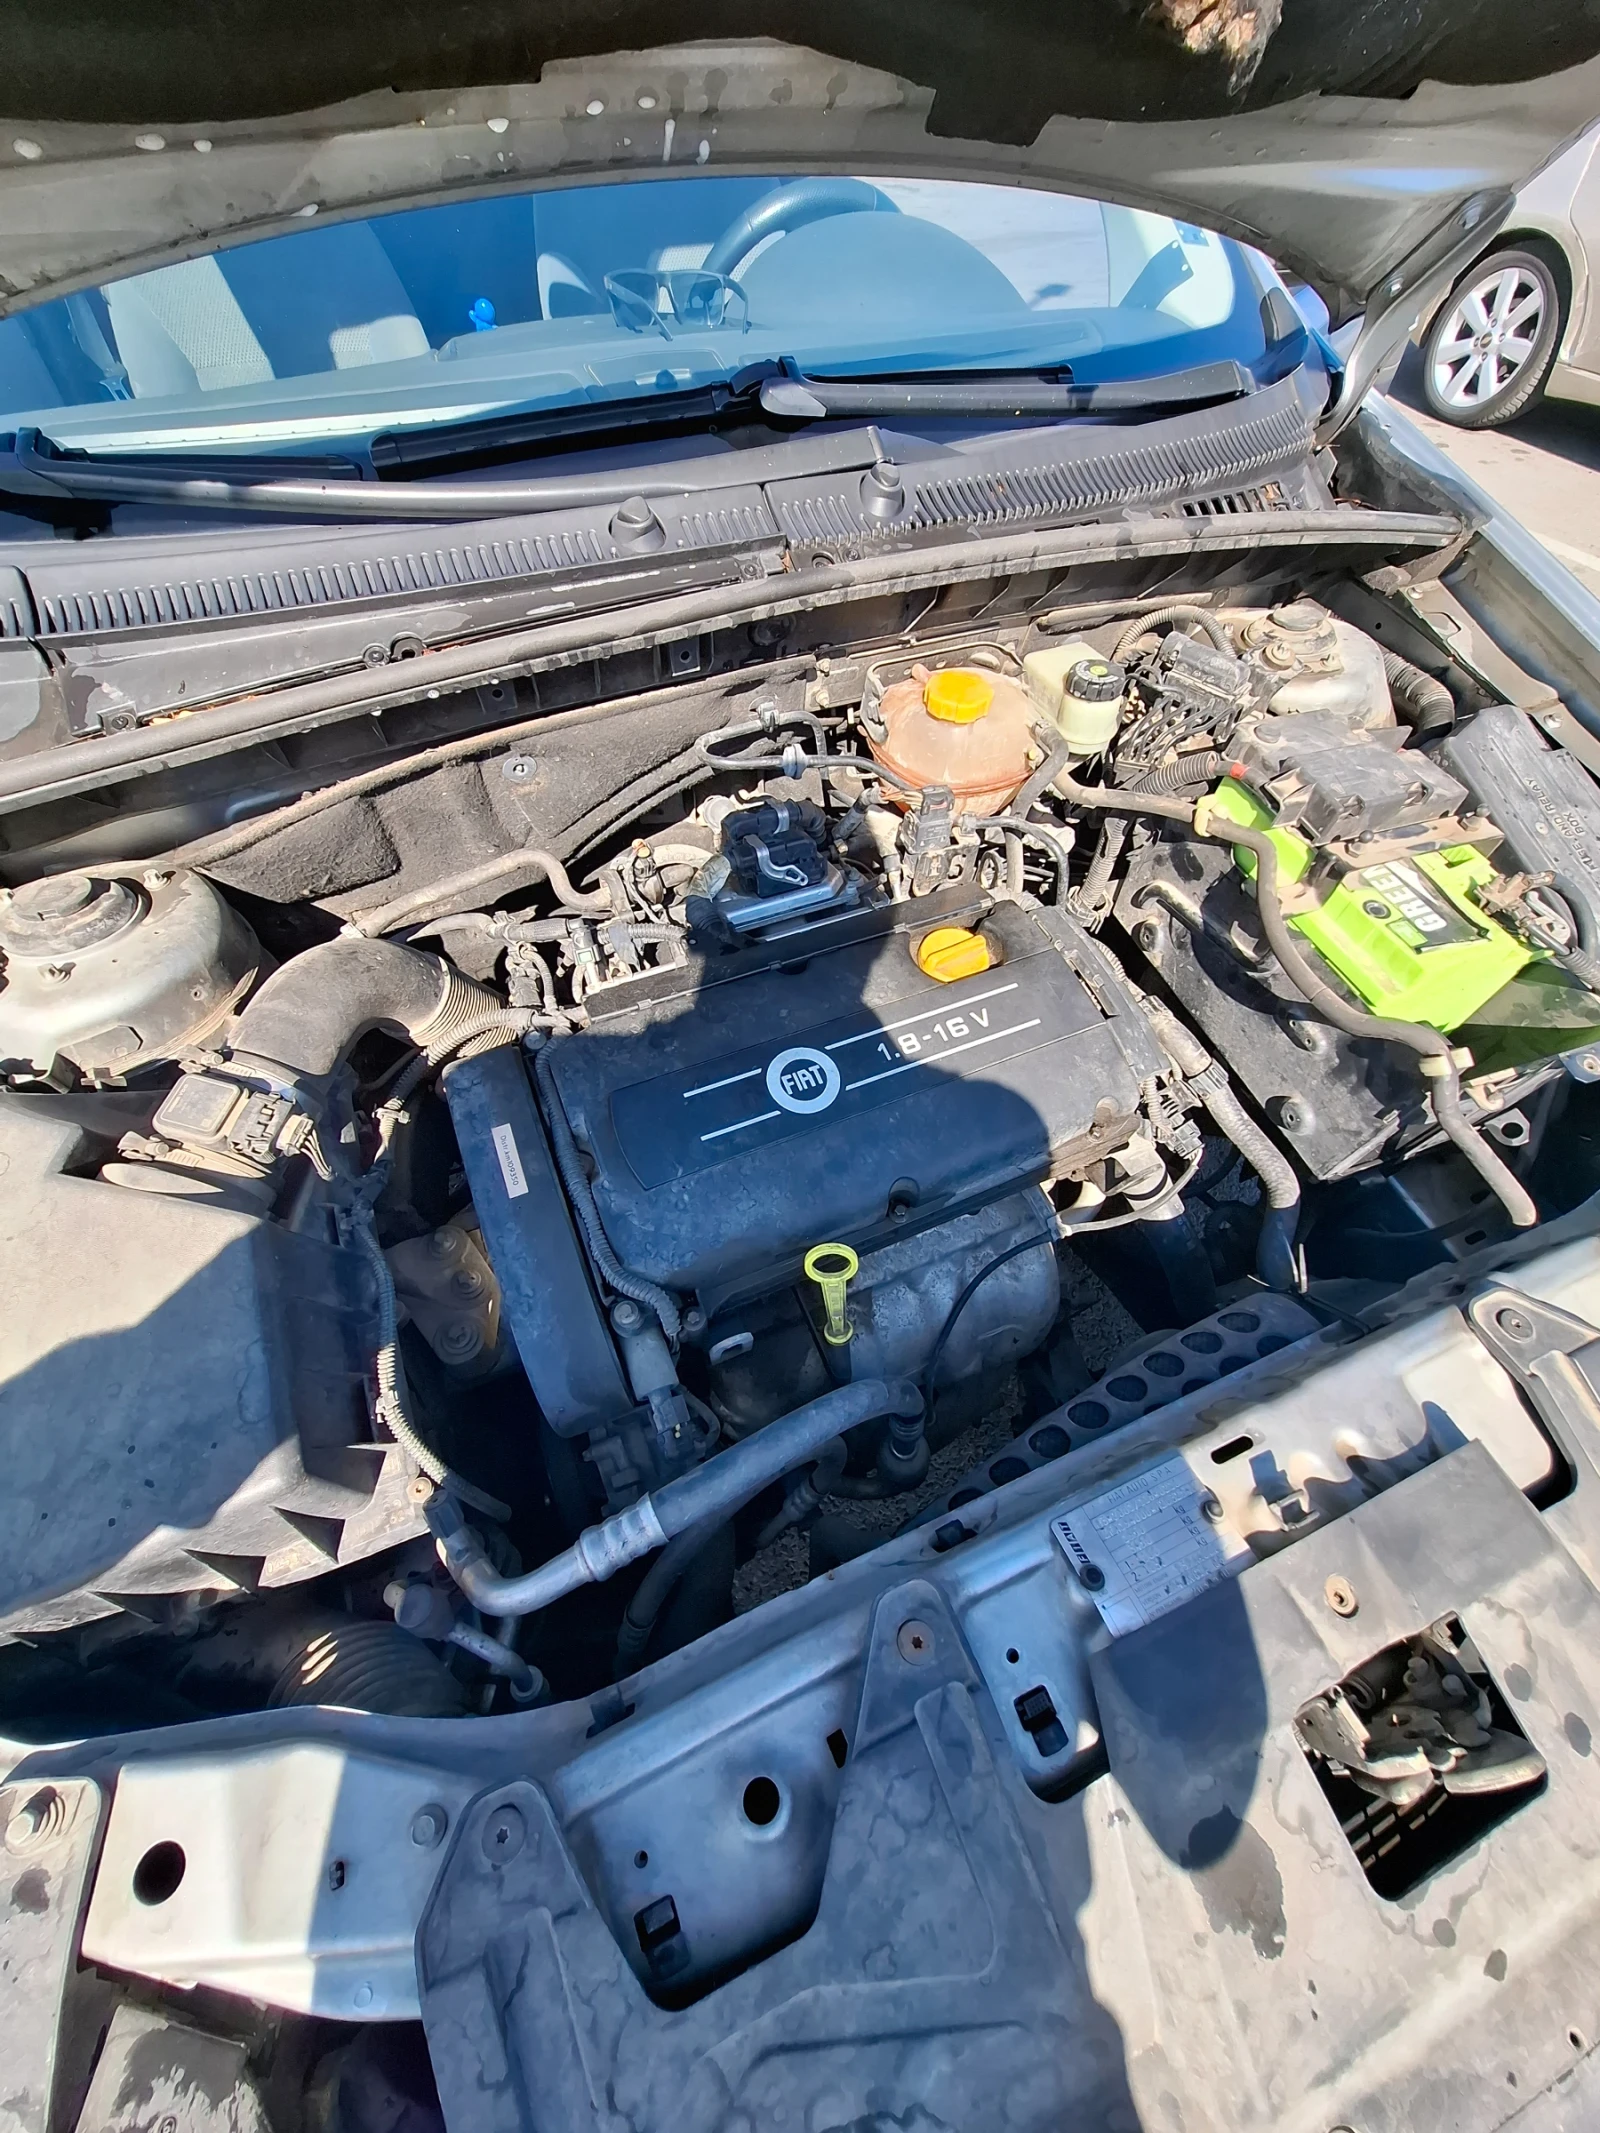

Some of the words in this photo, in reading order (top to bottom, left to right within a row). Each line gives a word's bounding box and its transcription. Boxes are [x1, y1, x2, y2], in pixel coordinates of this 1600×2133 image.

[1525, 777, 1555, 814] RELAY
[1554, 816, 1575, 838] AND
[1563, 812, 1585, 835] BOX
[780, 1064, 826, 1096] FIAT
[1106, 1486, 1126, 1504] FIAT
[1126, 1477, 1149, 1494] AUTO
[1172, 1504, 1186, 1514] kg
[1179, 1515, 1194, 1525] kg
[1187, 1526, 1201, 1536] kg
[1194, 1536, 1209, 1546] kg
[1057, 1521, 1091, 1564] FIAT
